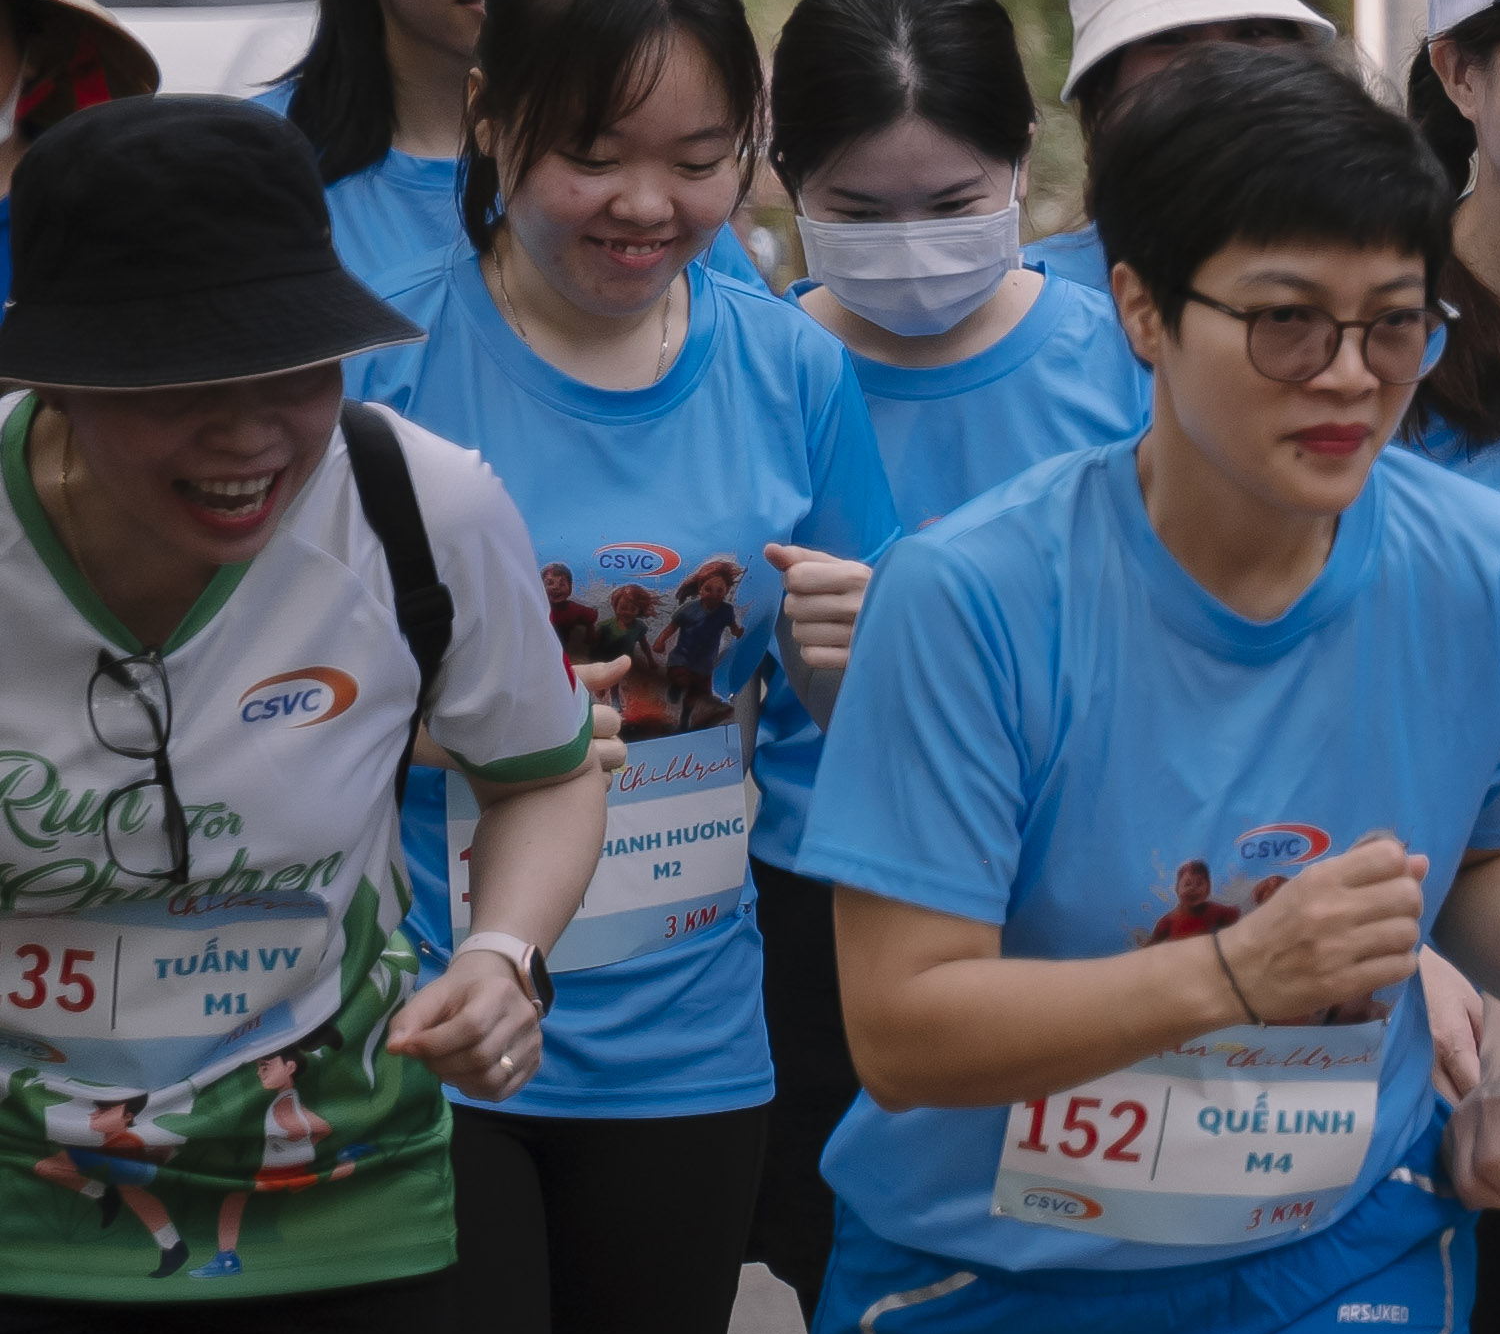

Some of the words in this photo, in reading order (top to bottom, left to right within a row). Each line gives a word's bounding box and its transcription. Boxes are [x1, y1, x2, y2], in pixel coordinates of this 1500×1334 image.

[600, 553, 655, 571] CSVC
[242, 688, 322, 723] CSVC
[619, 752, 741, 794] Children
[600, 827, 662, 859] HANH
[667, 816, 745, 852] HƯƠNG
[1239, 840, 1301, 861] CSVC
[653, 860, 682, 881] M2
[664, 914, 678, 939] 3
[683, 904, 719, 934] KM
[155, 936, 249, 981] TUẤN
[258, 947, 302, 972] VY
[0, 943, 97, 1013] 35
[203, 992, 251, 1017] M1
[1018, 1096, 1149, 1163] 152
[1197, 1093, 1269, 1135] QUẾ
[1276, 1109, 1355, 1135] LINH
[1245, 1151, 1294, 1174] M4
[1023, 1192, 1078, 1215] CSVC
[1246, 1207, 1262, 1230] 3
[1270, 1200, 1316, 1224] KM
